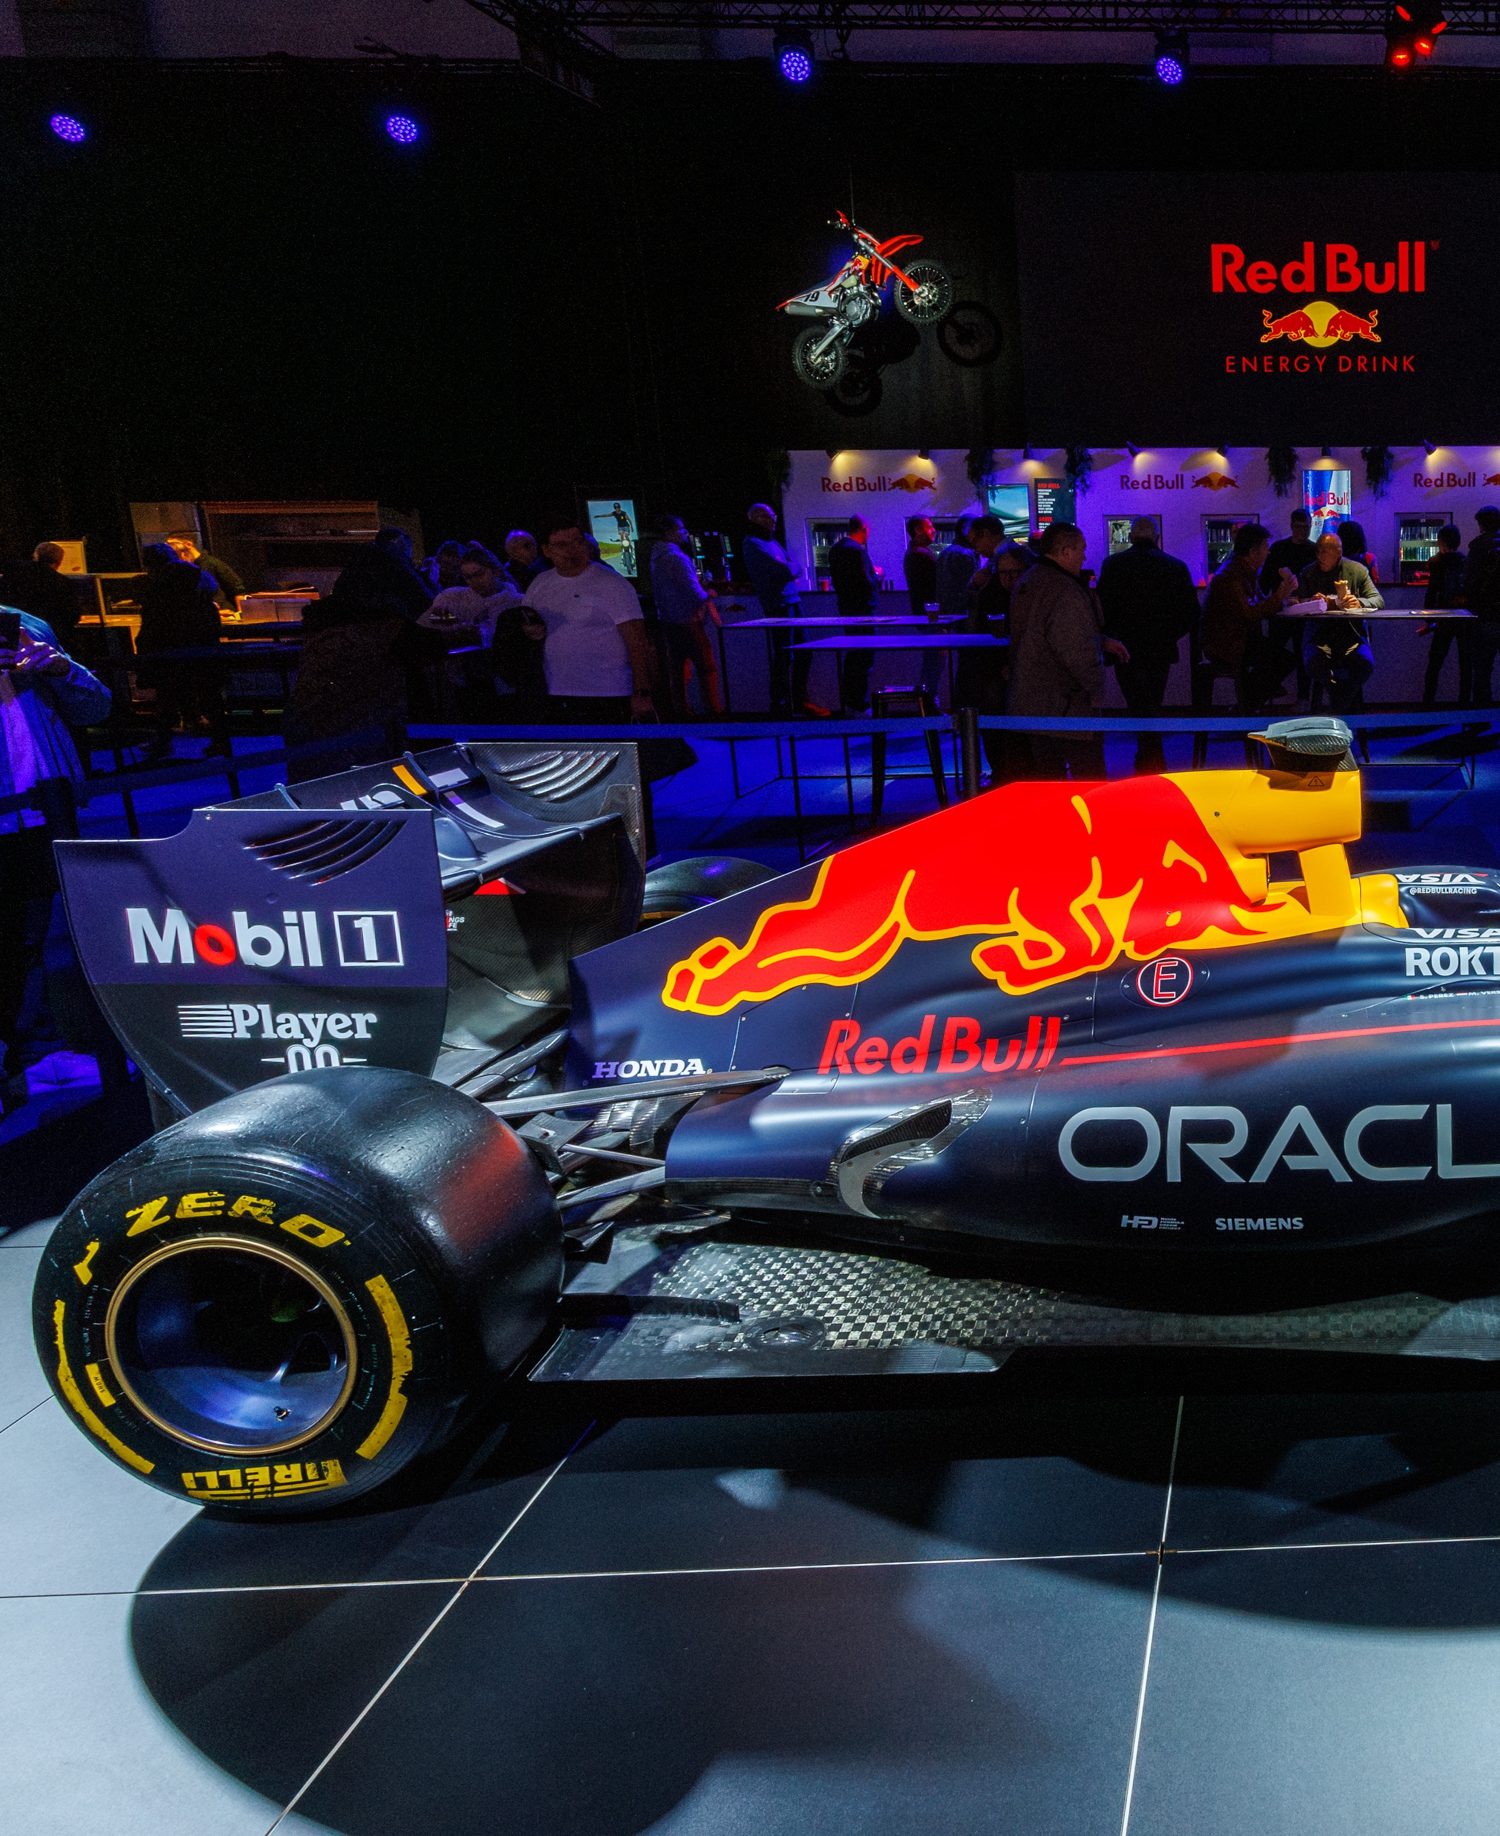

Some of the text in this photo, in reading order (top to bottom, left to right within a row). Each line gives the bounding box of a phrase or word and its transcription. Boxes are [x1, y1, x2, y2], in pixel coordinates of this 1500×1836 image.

[1211, 241, 1426, 293] Red Bull
[1225, 355, 1416, 374] ENERGY DRINK
[821, 476, 887, 493] Red Bull
[1120, 474, 1184, 490] Red Bull
[1413, 472, 1476, 487] Red Bull
[1409, 886, 1478, 896] @REDBULLRACING
[125, 907, 324, 967] Mobil
[1151, 960, 1178, 1001] E
[229, 1004, 378, 1048] Player
[817, 1014, 1062, 1076] Red Bull
[591, 1058, 705, 1080] HONDA
[125, 1190, 346, 1248] ZERO
[1215, 1217, 1305, 1231] SIEMENS
